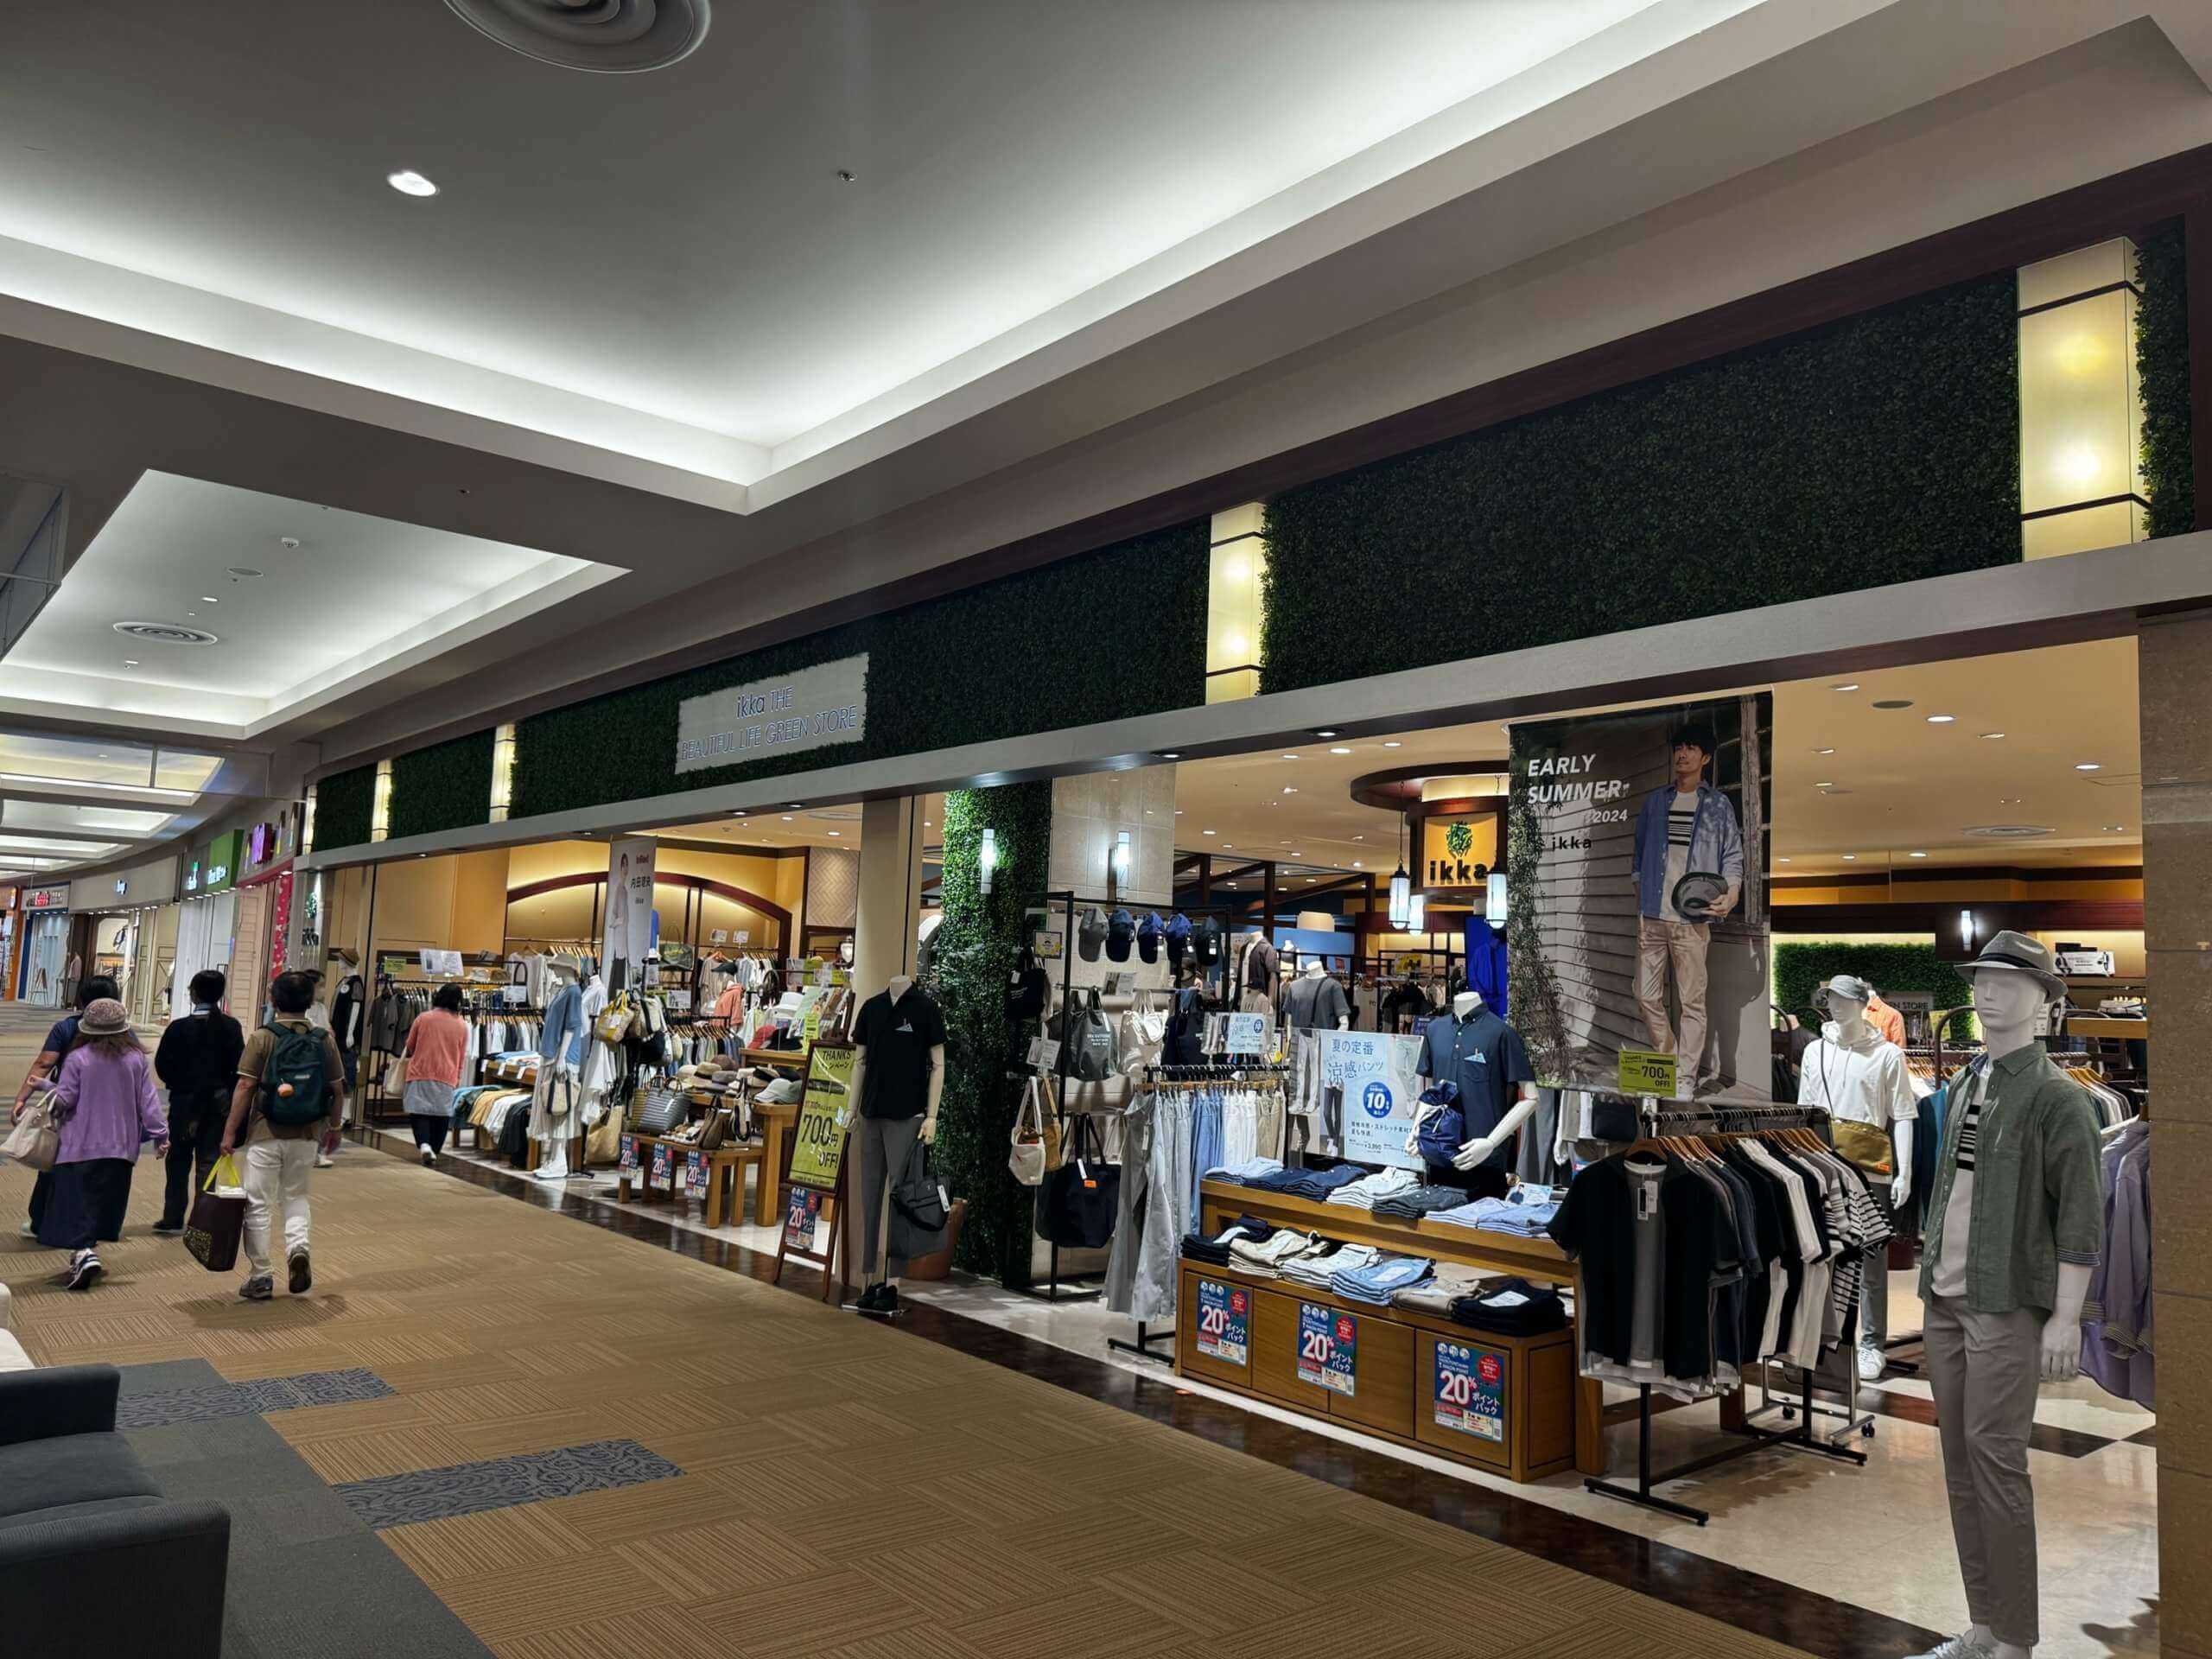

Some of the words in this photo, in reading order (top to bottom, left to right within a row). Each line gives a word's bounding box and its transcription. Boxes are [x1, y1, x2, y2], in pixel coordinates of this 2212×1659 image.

[736, 694, 765, 719] ikka
[770, 686, 793, 712] THE
[681, 730, 735, 761] BEAUTIFUL
[740, 724, 762, 749] LIFE
[766, 716, 810, 746] GREEN
[814, 704, 857, 736] STORE
[1528, 753, 1597, 777] EARLY
[1528, 779, 1622, 804] SUMMER
[1594, 809, 1628, 823] 2024
[1552, 836, 1592, 852] ikka
[1429, 859, 1488, 886] ikka
[823, 1050, 851, 1059] THANKS
[1332, 1039, 1374, 1055] 夏の定番
[1440, 1370, 1478, 1405] 20%
[1472, 1391, 1500, 1407] ポイント
[1475, 1402, 1497, 1415] バック
